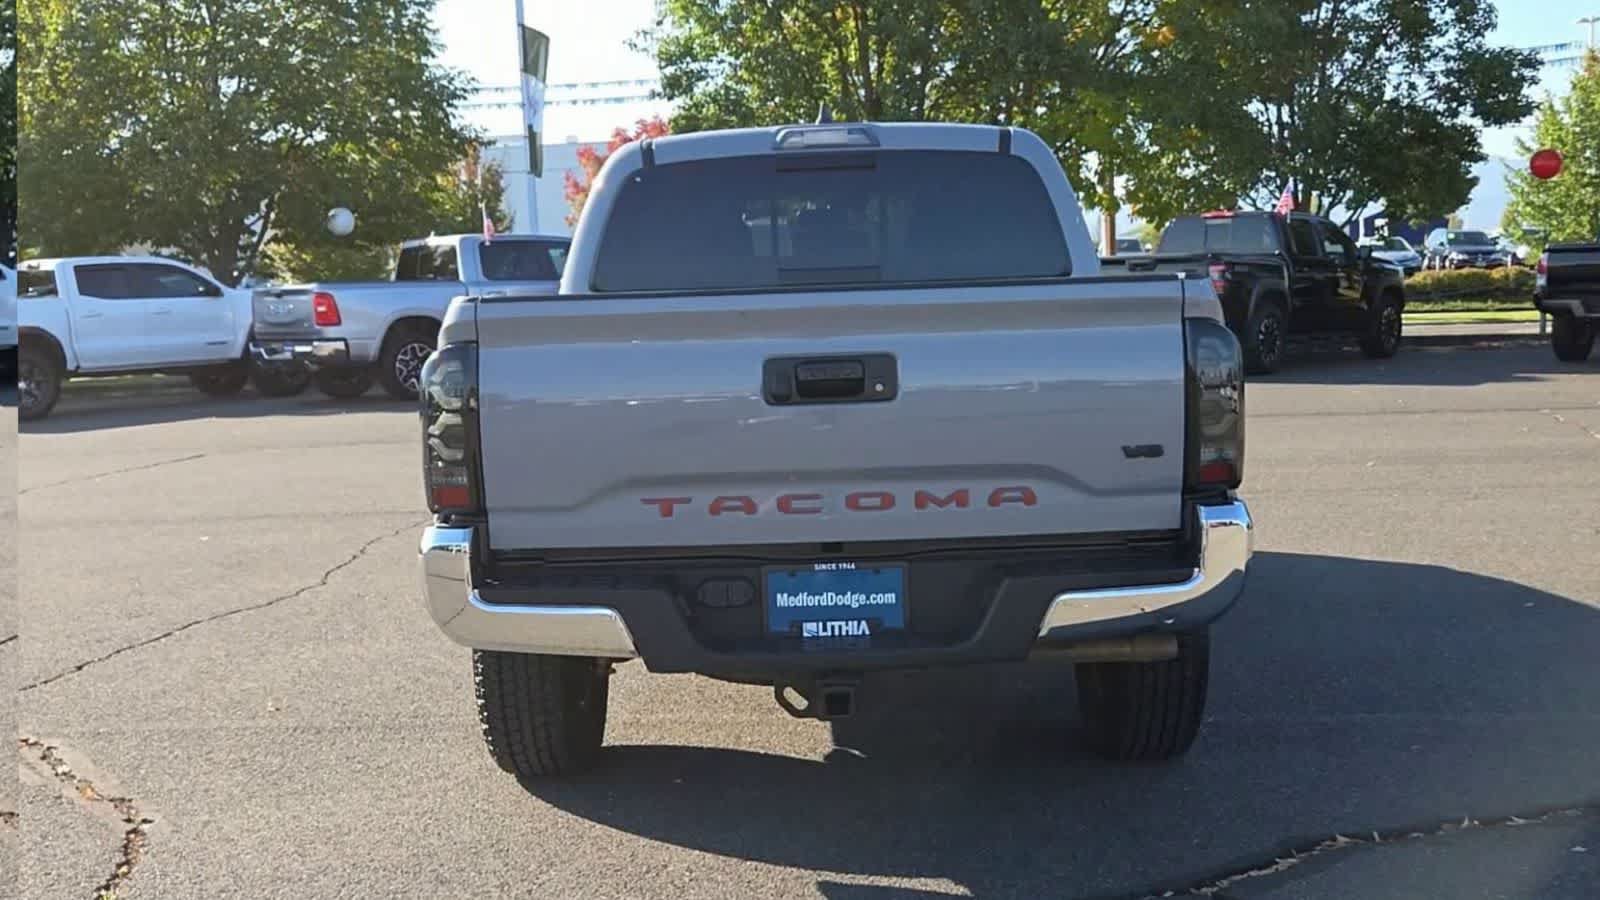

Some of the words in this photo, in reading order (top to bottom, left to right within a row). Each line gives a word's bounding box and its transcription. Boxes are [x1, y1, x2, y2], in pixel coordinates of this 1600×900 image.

[640, 485, 1038, 518] TACOMA
[814, 563, 837, 571] SINCE
[776, 591, 897, 608] MedfordDodge.com
[818, 620, 870, 636] LITHIA
